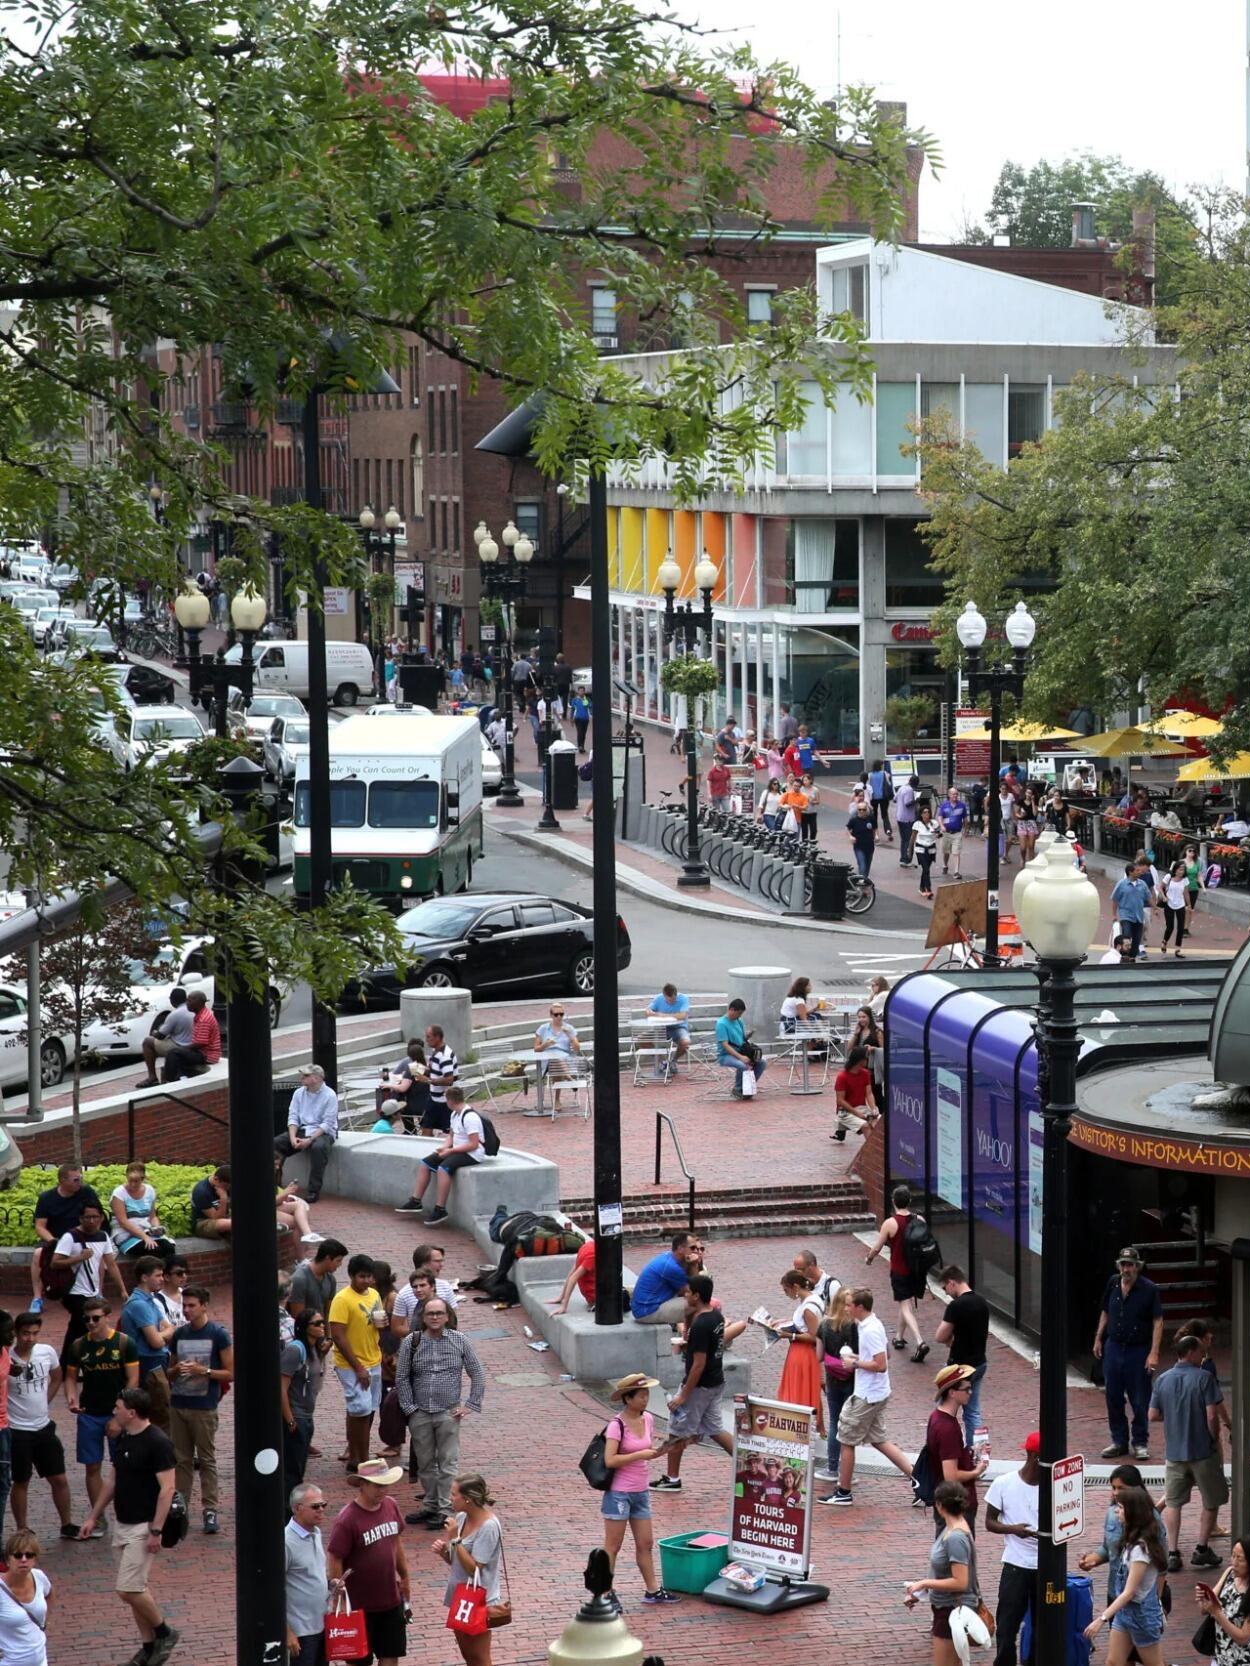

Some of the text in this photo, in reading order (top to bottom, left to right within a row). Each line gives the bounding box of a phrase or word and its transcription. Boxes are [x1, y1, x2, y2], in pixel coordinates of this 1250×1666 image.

[346, 766, 361, 774] You
[363, 766, 379, 774] Can
[381, 766, 405, 774] Count
[892, 1086, 923, 1126] YAHOO!
[1079, 1120, 1127, 1153] VISITOR'S
[976, 1128, 1012, 1171] YAHOO!
[769, 1415, 809, 1434] HARVARD
[1054, 1459, 1083, 1478] TOW ZONE
[1062, 1480, 1073, 1493] NO
[753, 1503, 785, 1519] TOURS
[1056, 1498, 1081, 1515] PARKING
[739, 1514, 798, 1536] OF HARVARD
[741, 1528, 795, 1550] BEGIN HERE
[454, 1599, 474, 1623] H
